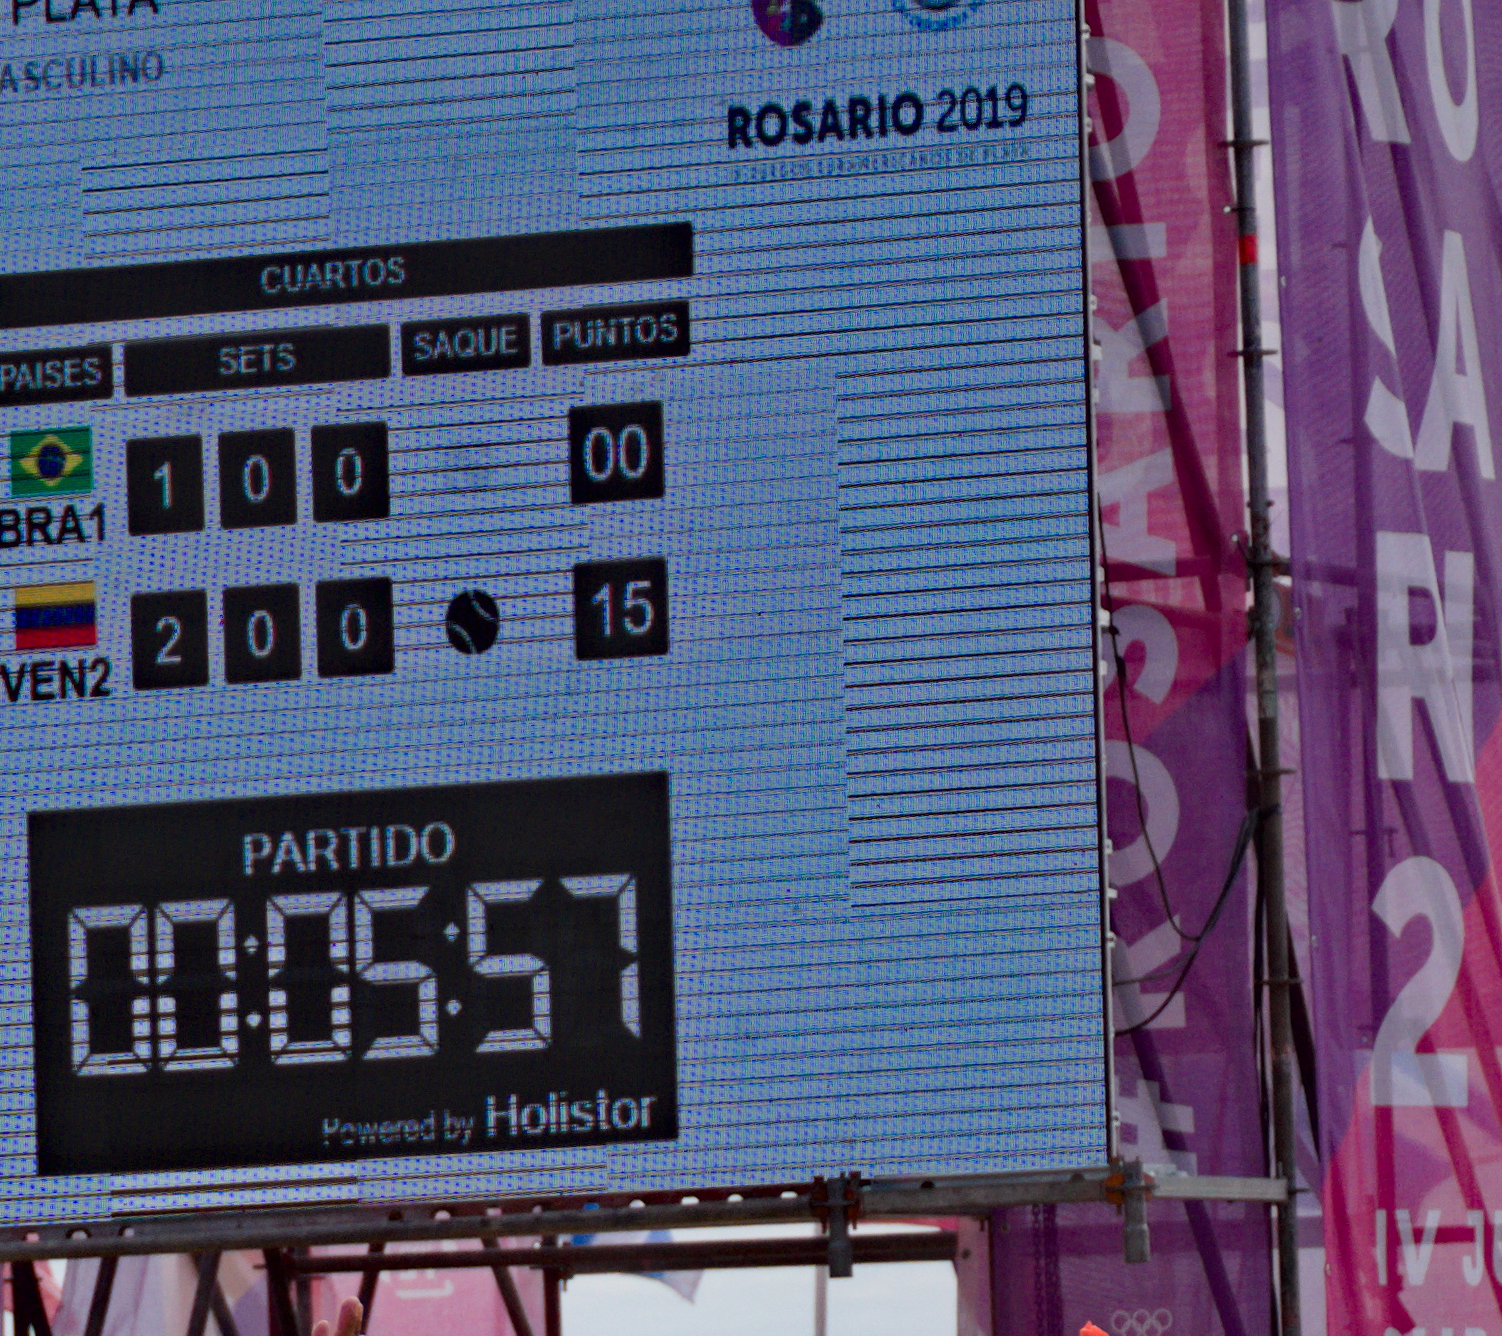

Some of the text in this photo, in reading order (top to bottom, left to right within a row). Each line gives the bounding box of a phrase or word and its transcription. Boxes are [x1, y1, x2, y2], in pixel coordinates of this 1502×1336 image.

[727, 82, 1028, 149] ROSARIO 2019
[260, 256, 407, 296] CUARTOS
[218, 342, 297, 377] SETS
[413, 326, 520, 362] SAQUE
[552, 313, 679, 352] PUNTOS
[583, 423, 649, 484] 00
[154, 616, 183, 665] 2
[591, 580, 653, 636] 15
[0, 656, 113, 703] VEN2
[243, 821, 456, 876] PARTIDO
[68, 874, 641, 1077] 00:05:57
[323, 1088, 658, 1146] Powered by Holistor
[1374, 1207, 1442, 1288] IV
